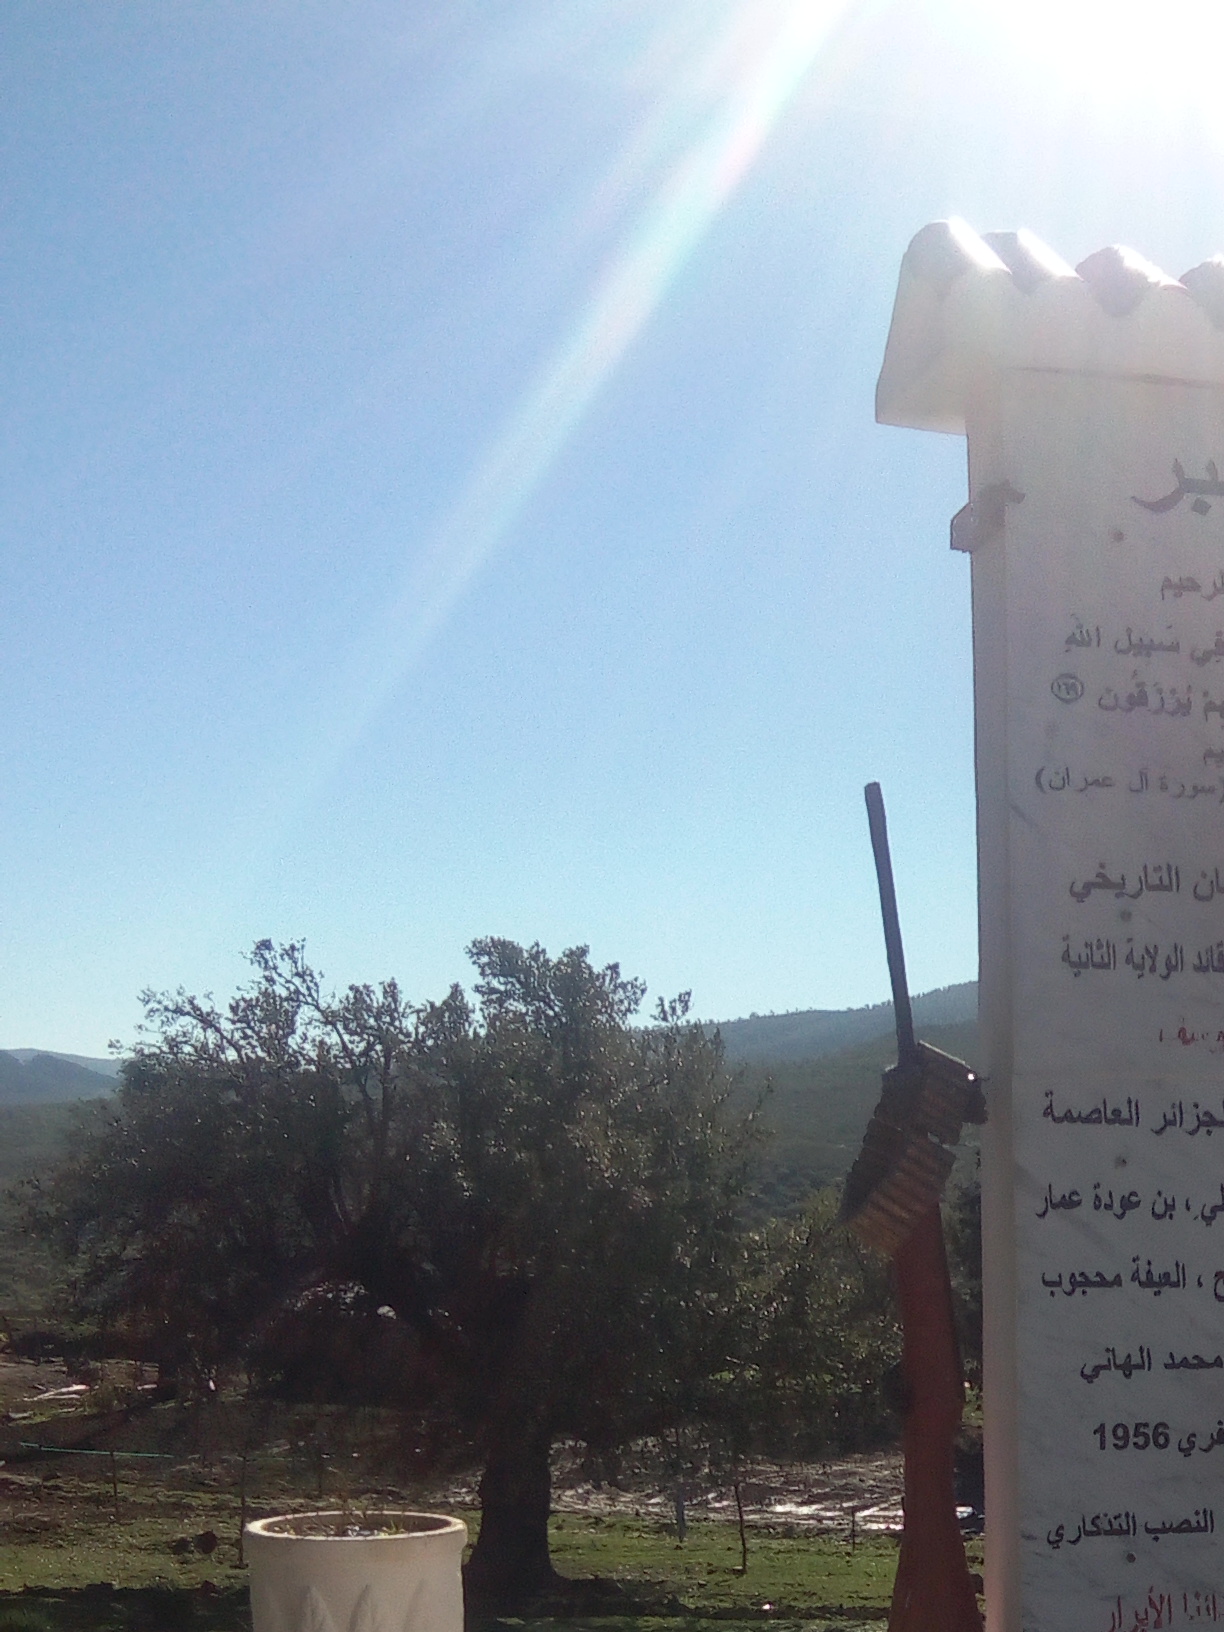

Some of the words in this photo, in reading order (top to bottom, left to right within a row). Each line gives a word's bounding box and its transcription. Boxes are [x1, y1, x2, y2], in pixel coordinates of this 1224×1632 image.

[1034, 765, 1115, 795] عمران)
[1069, 862, 1180, 903] التاريخي
[1061, 934, 1117, 979] الثانية
[1124, 937, 1184, 981] الولاية
[1042, 1090, 1141, 1128] العاصمة
[1034, 1181, 1083, 1219] عمار
[1092, 1182, 1142, 1221] عودة
[1151, 1189, 1177, 1221] بن
[1040, 1270, 1123, 1298] محجوب
[1129, 1254, 1187, 1297] العيفة
[1079, 1344, 1152, 1385] الهاني
[1163, 1350, 1224, 1371] محمد
[1092, 1421, 1171, 1451] 1956
[1046, 1510, 1138, 1550] التذكاري
[1143, 1507, 1216, 1544] النصب
